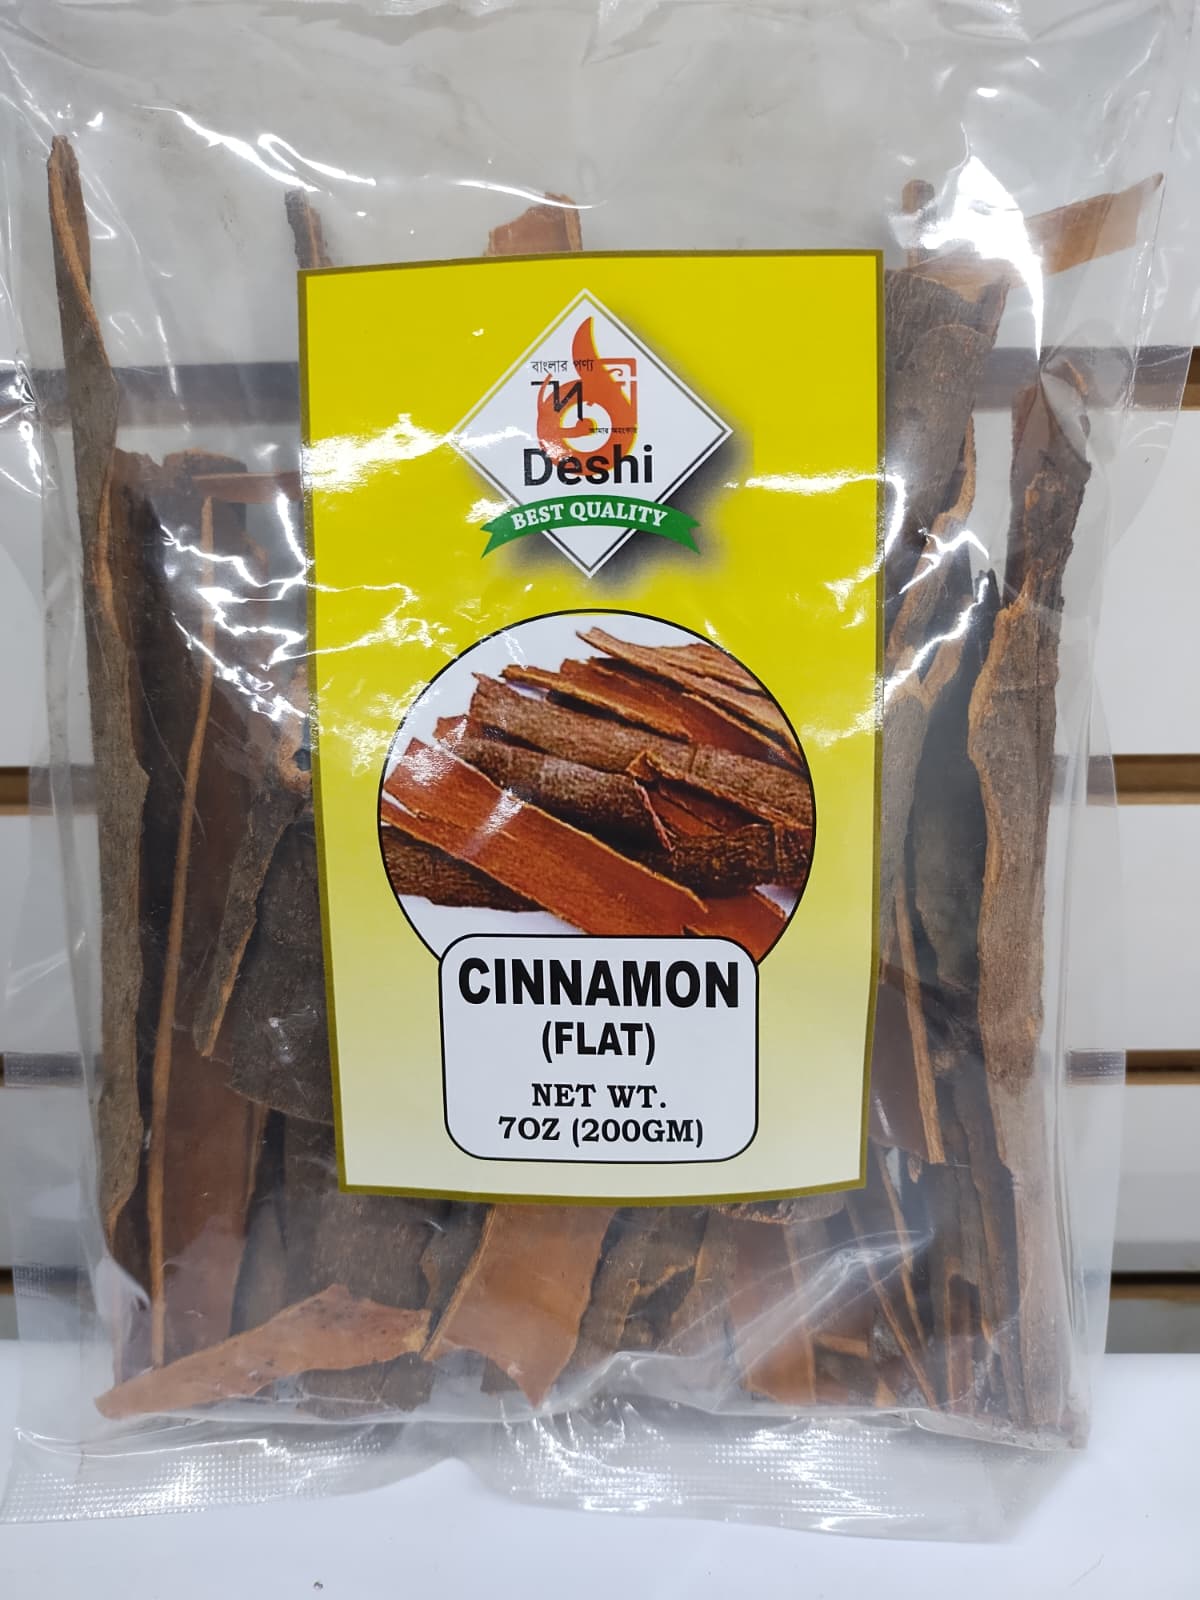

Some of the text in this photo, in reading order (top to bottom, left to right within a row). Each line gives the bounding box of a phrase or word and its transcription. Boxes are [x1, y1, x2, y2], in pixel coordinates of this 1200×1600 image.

[530, 358, 594, 373] বাংলার পণ্য
[523, 443, 653, 486] Deshi
[510, 502, 668, 530] BEST QUALITY
[458, 957, 739, 1008] CINNAMON
[542, 1020, 656, 1065] (FLAT)
[531, 1083, 667, 1108] NET WT.
[498, 1116, 704, 1148] 7OZ (200GM)
